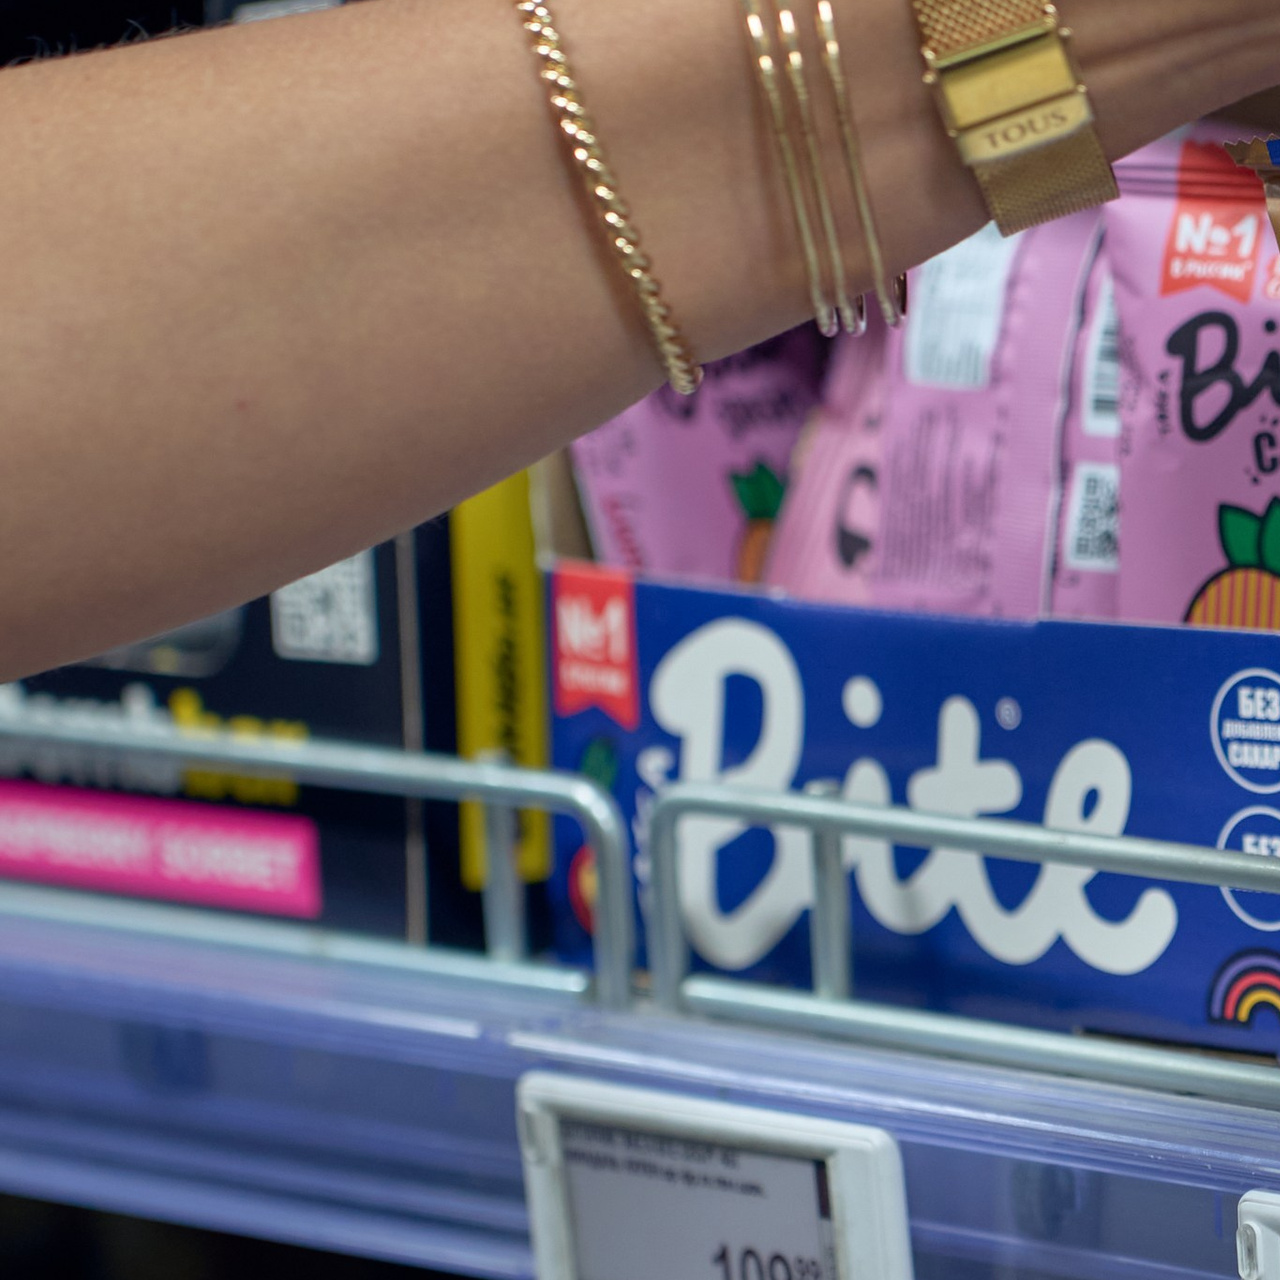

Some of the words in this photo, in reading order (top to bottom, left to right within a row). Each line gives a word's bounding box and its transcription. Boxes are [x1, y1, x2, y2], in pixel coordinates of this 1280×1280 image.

[983, 108, 1067, 149] TOUS
[1176, 212, 1261, 257] №1
[650, 615, 1179, 977] Bite
